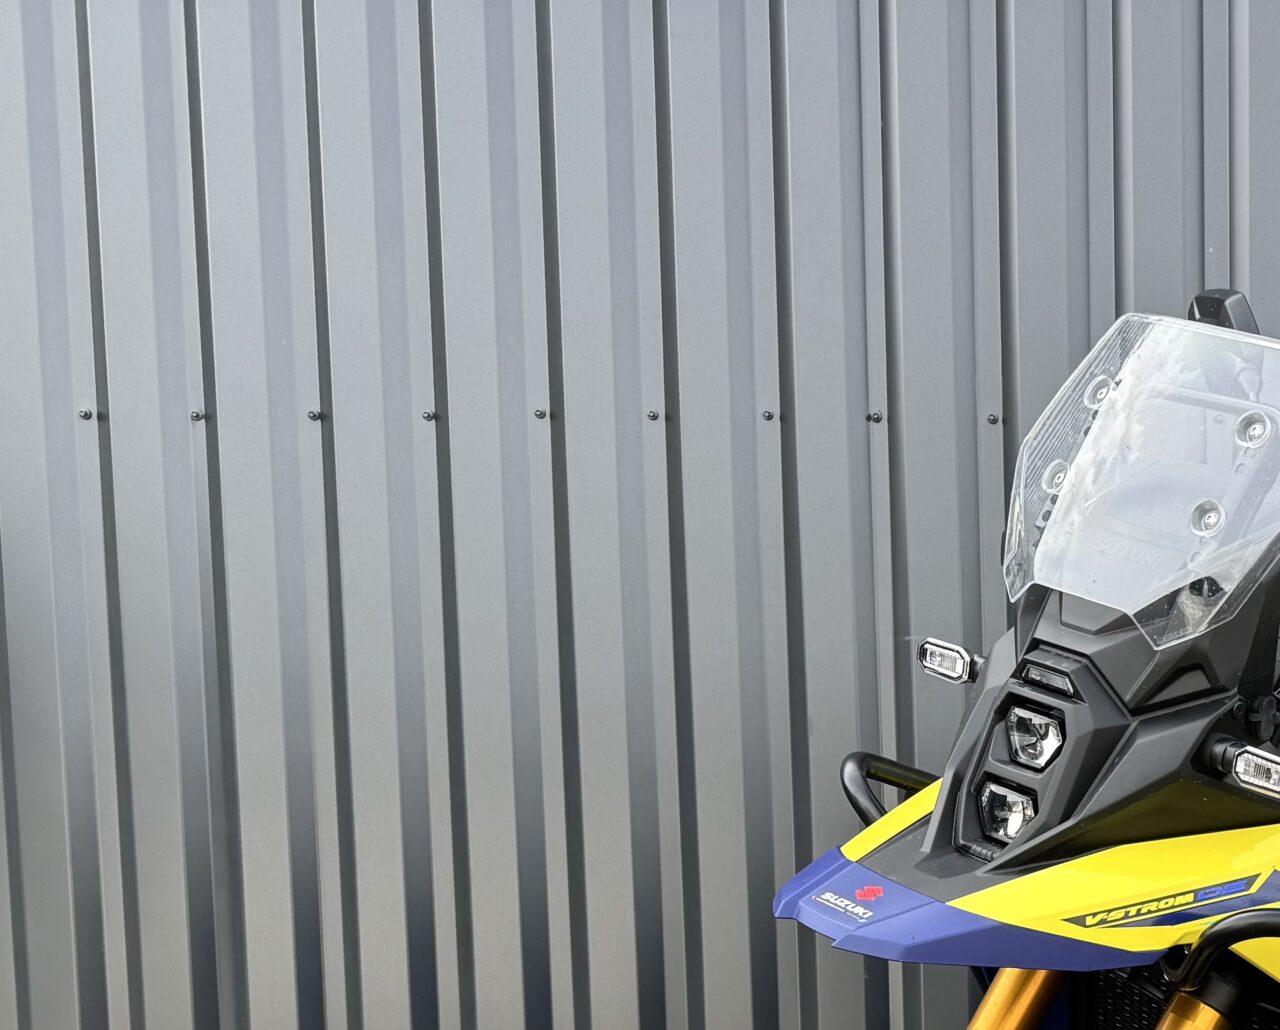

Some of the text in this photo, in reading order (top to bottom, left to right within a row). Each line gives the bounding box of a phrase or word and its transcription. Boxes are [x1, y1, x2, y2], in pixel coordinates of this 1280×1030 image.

[820, 892, 874, 918] SUZUKI
[1086, 880, 1247, 926] V-STROM DE
